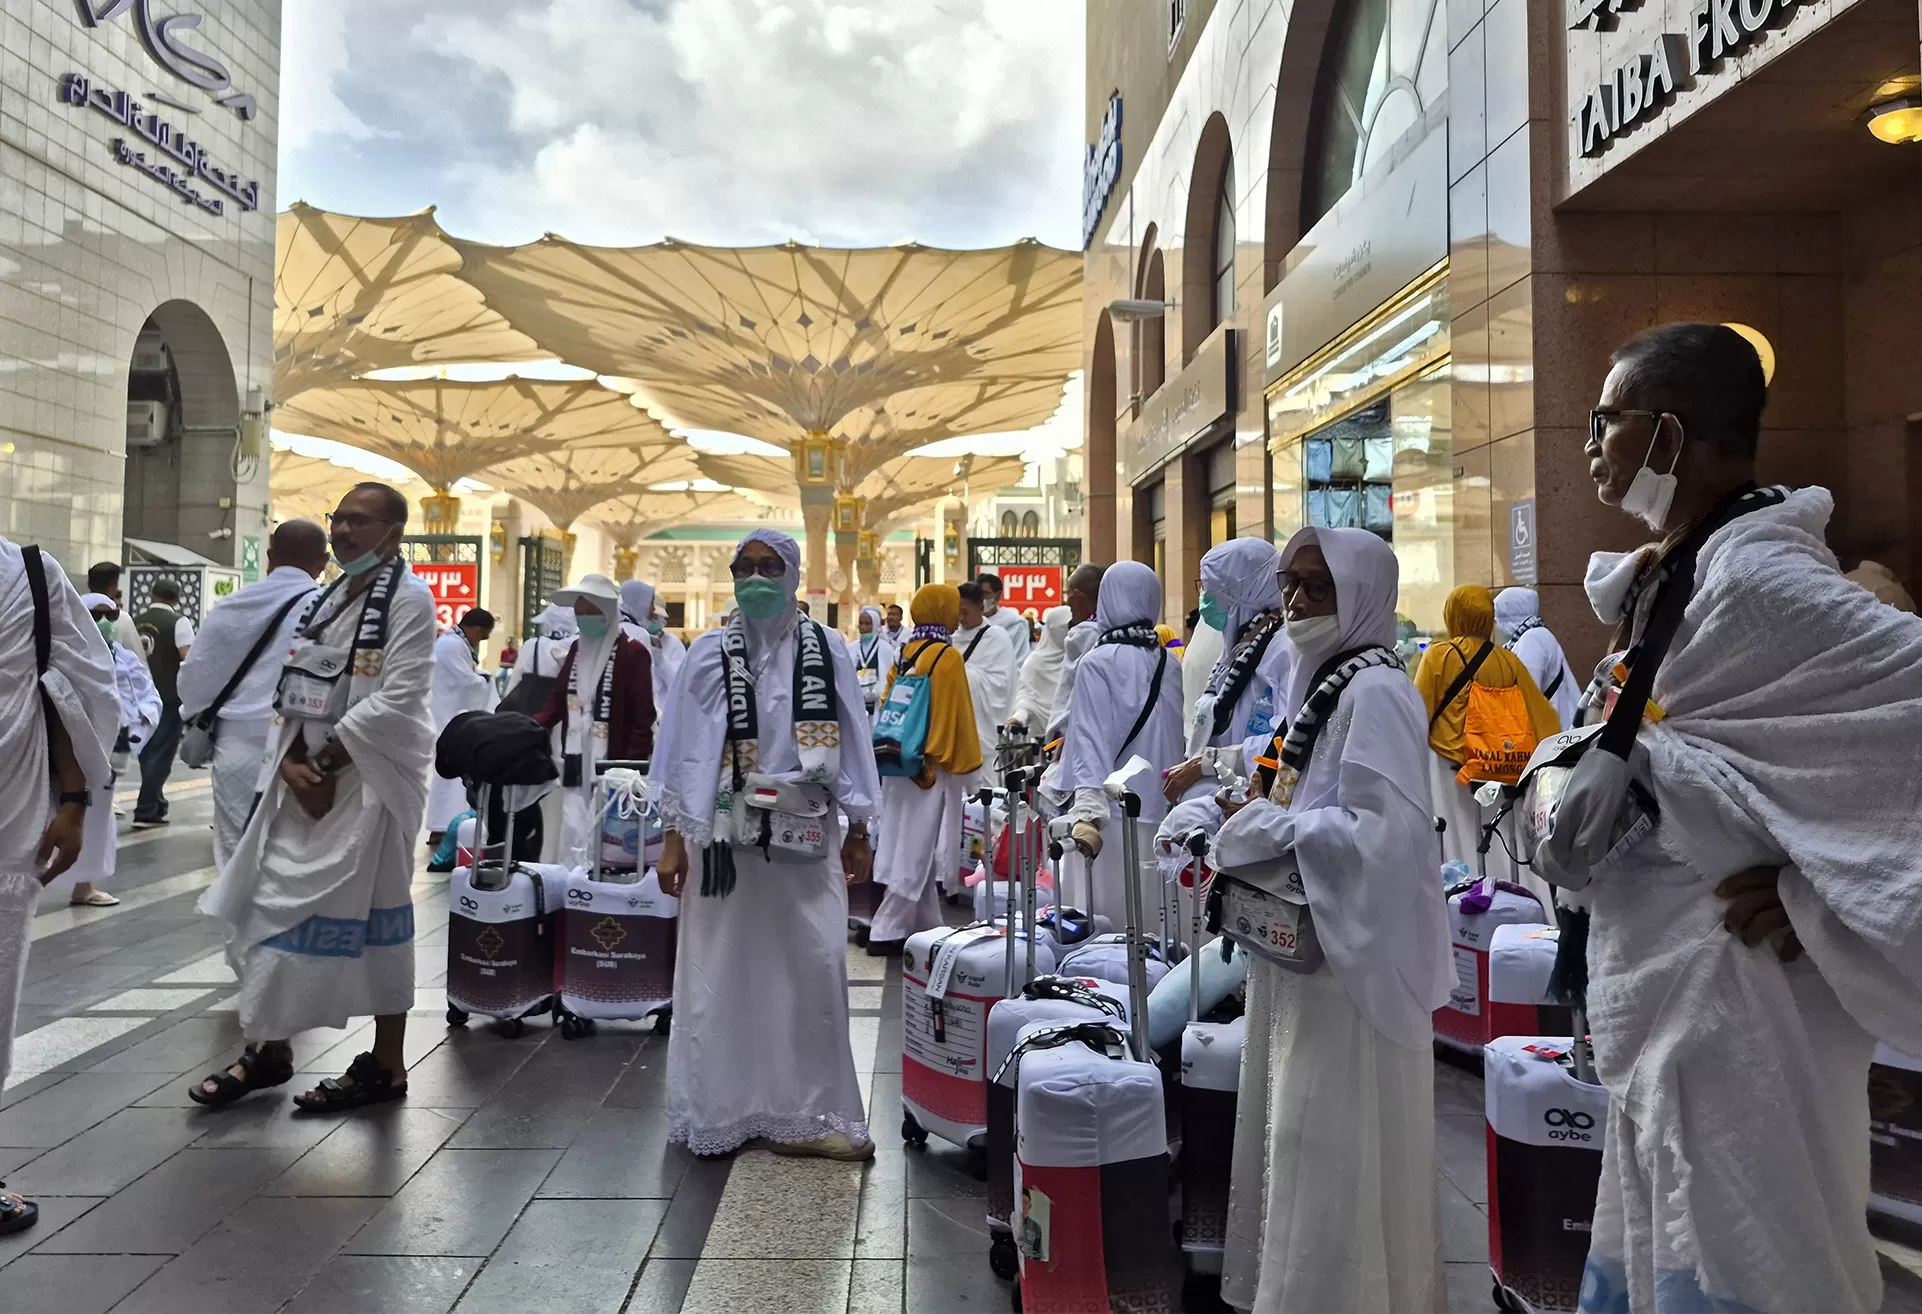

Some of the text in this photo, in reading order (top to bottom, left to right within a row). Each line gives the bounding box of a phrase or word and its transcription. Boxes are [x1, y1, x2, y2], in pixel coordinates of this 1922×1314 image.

[1573, 0, 1792, 158] TAIBA FRO
[1003, 574, 1056, 601] ٣٣٠
[436, 603, 472, 630] 30
[1271, 930, 1295, 949] 352
[570, 946, 647, 960] Embarkasi Surabaya
[1548, 1129, 1592, 1141] aybe
